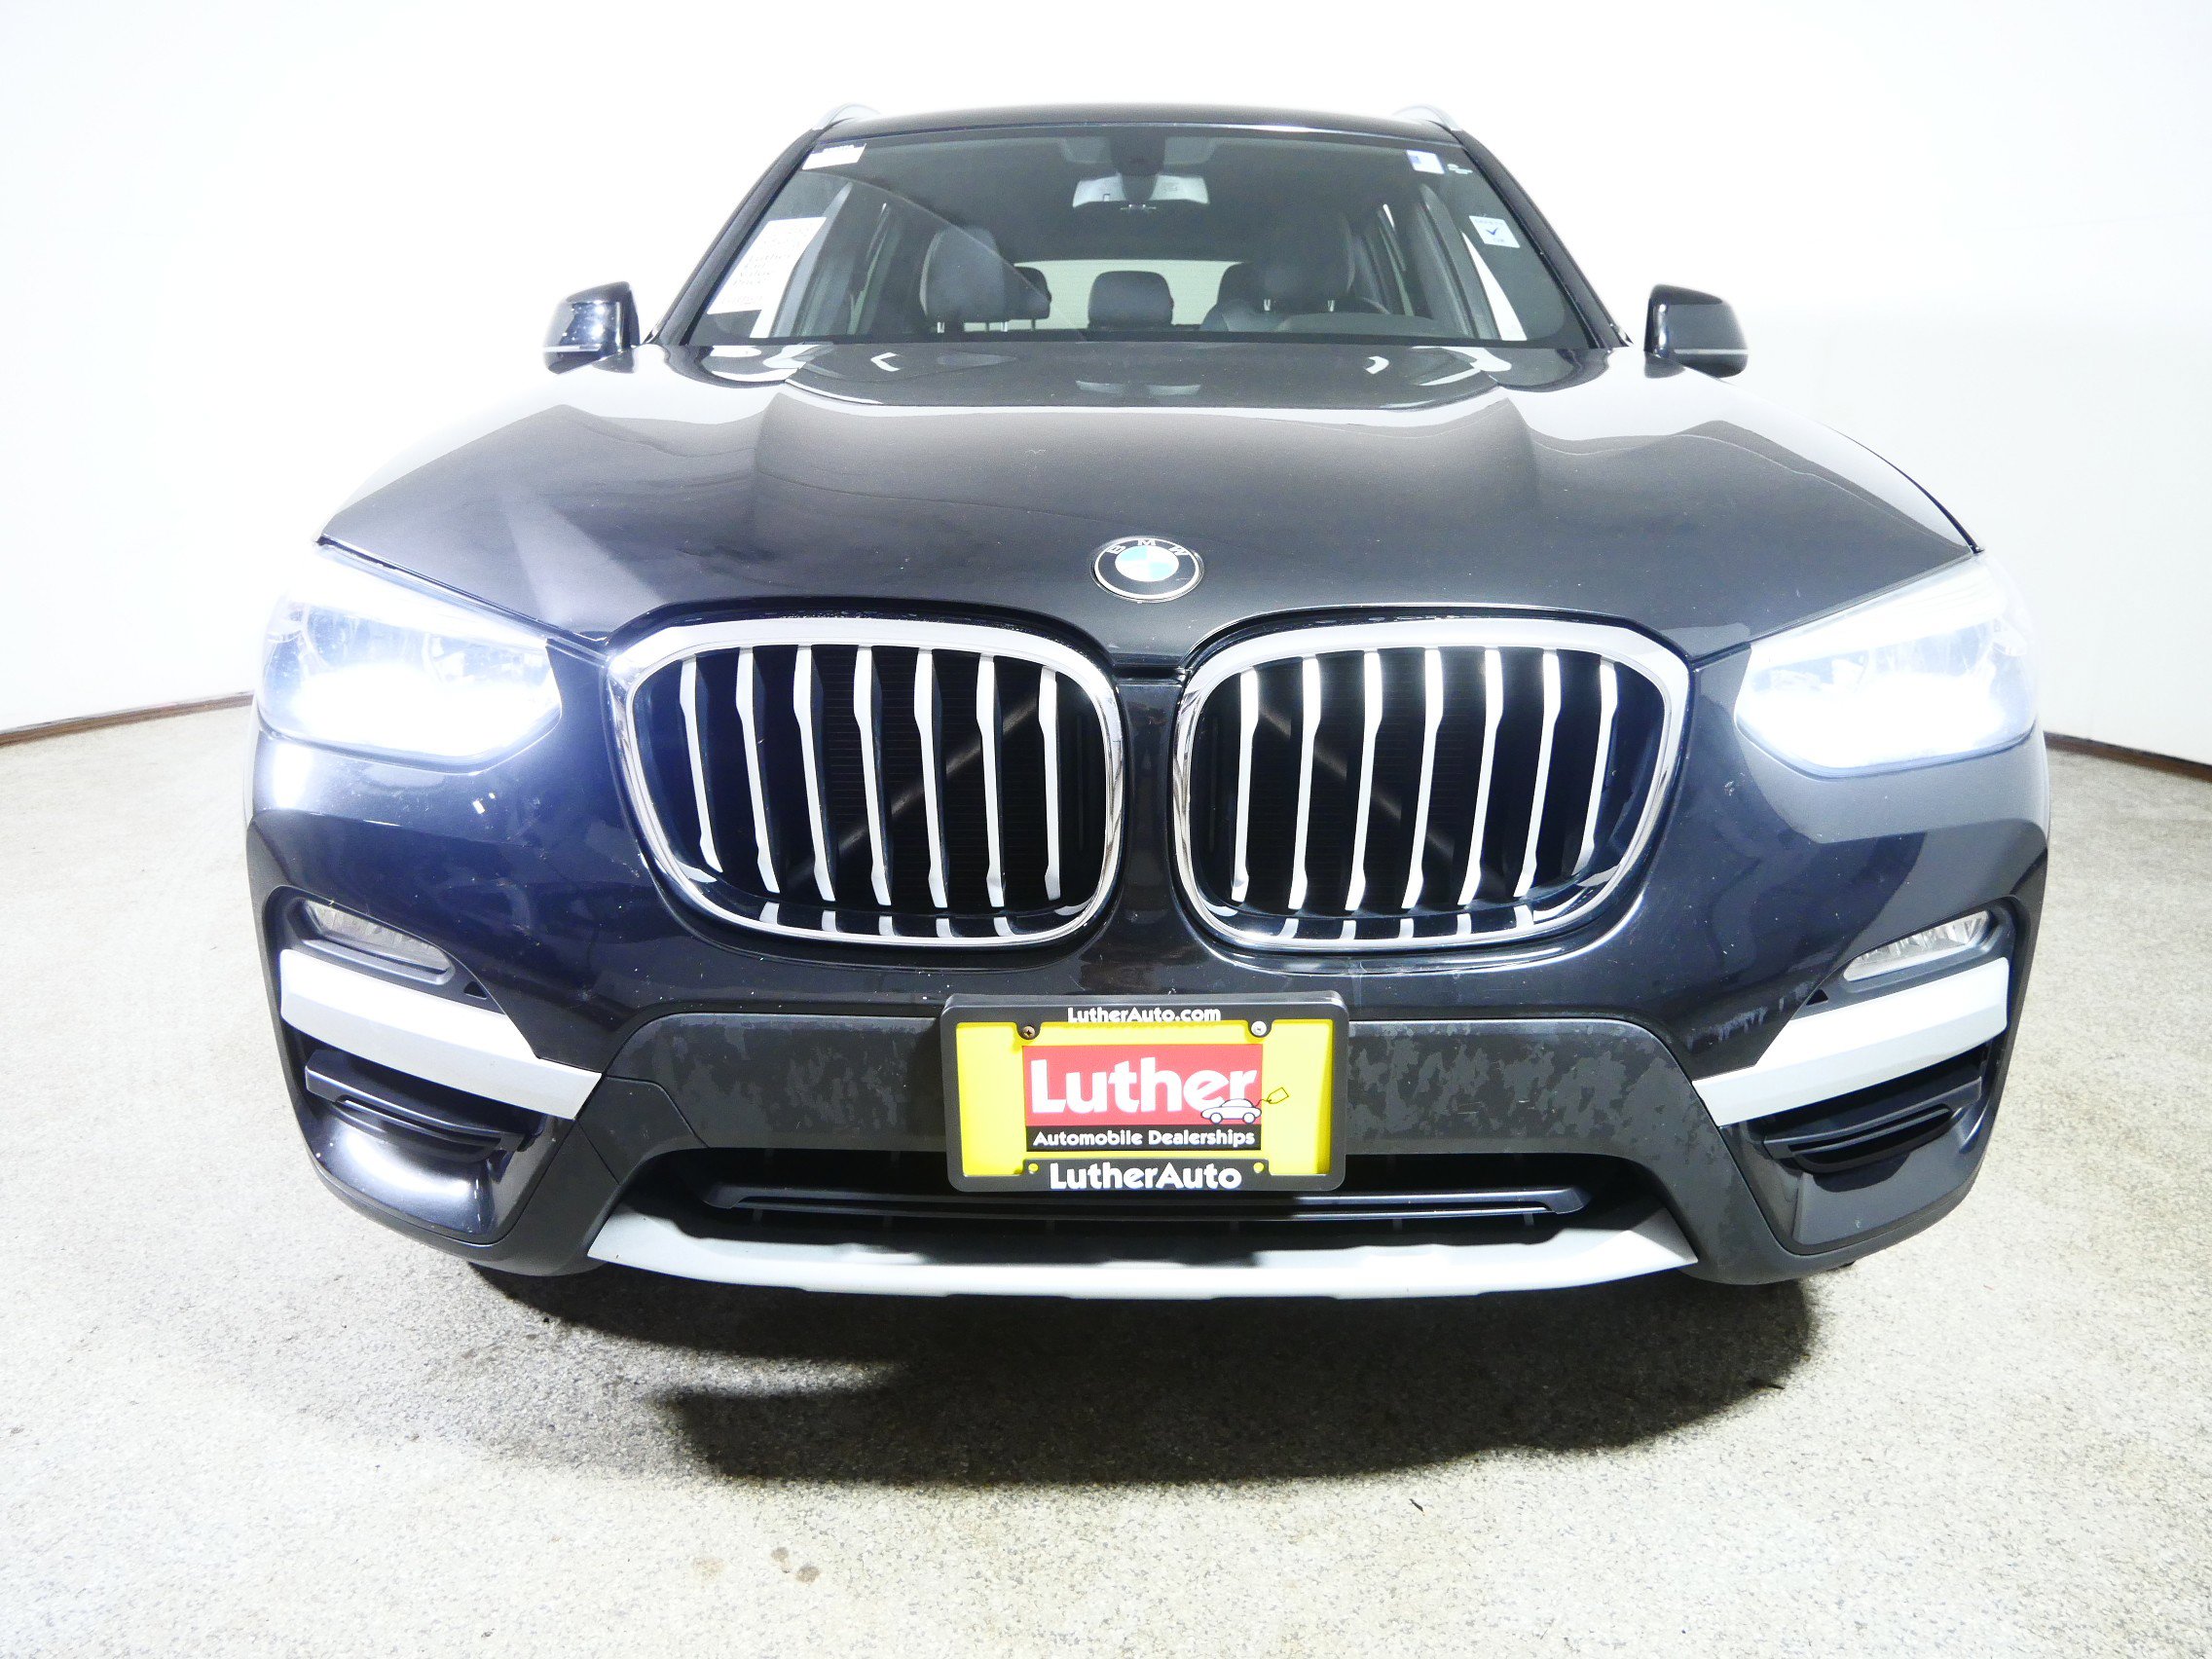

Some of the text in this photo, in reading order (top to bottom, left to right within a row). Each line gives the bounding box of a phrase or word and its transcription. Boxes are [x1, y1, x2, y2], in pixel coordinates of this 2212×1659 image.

[1106, 538, 1189, 556] BMW
[1067, 1007, 1222, 1022] LutherAuto.com
[1029, 1056, 1258, 1115] Luther
[1033, 1128, 1256, 1147] Automobile Dealerships
[1050, 1161, 1242, 1190] LutherAuto
